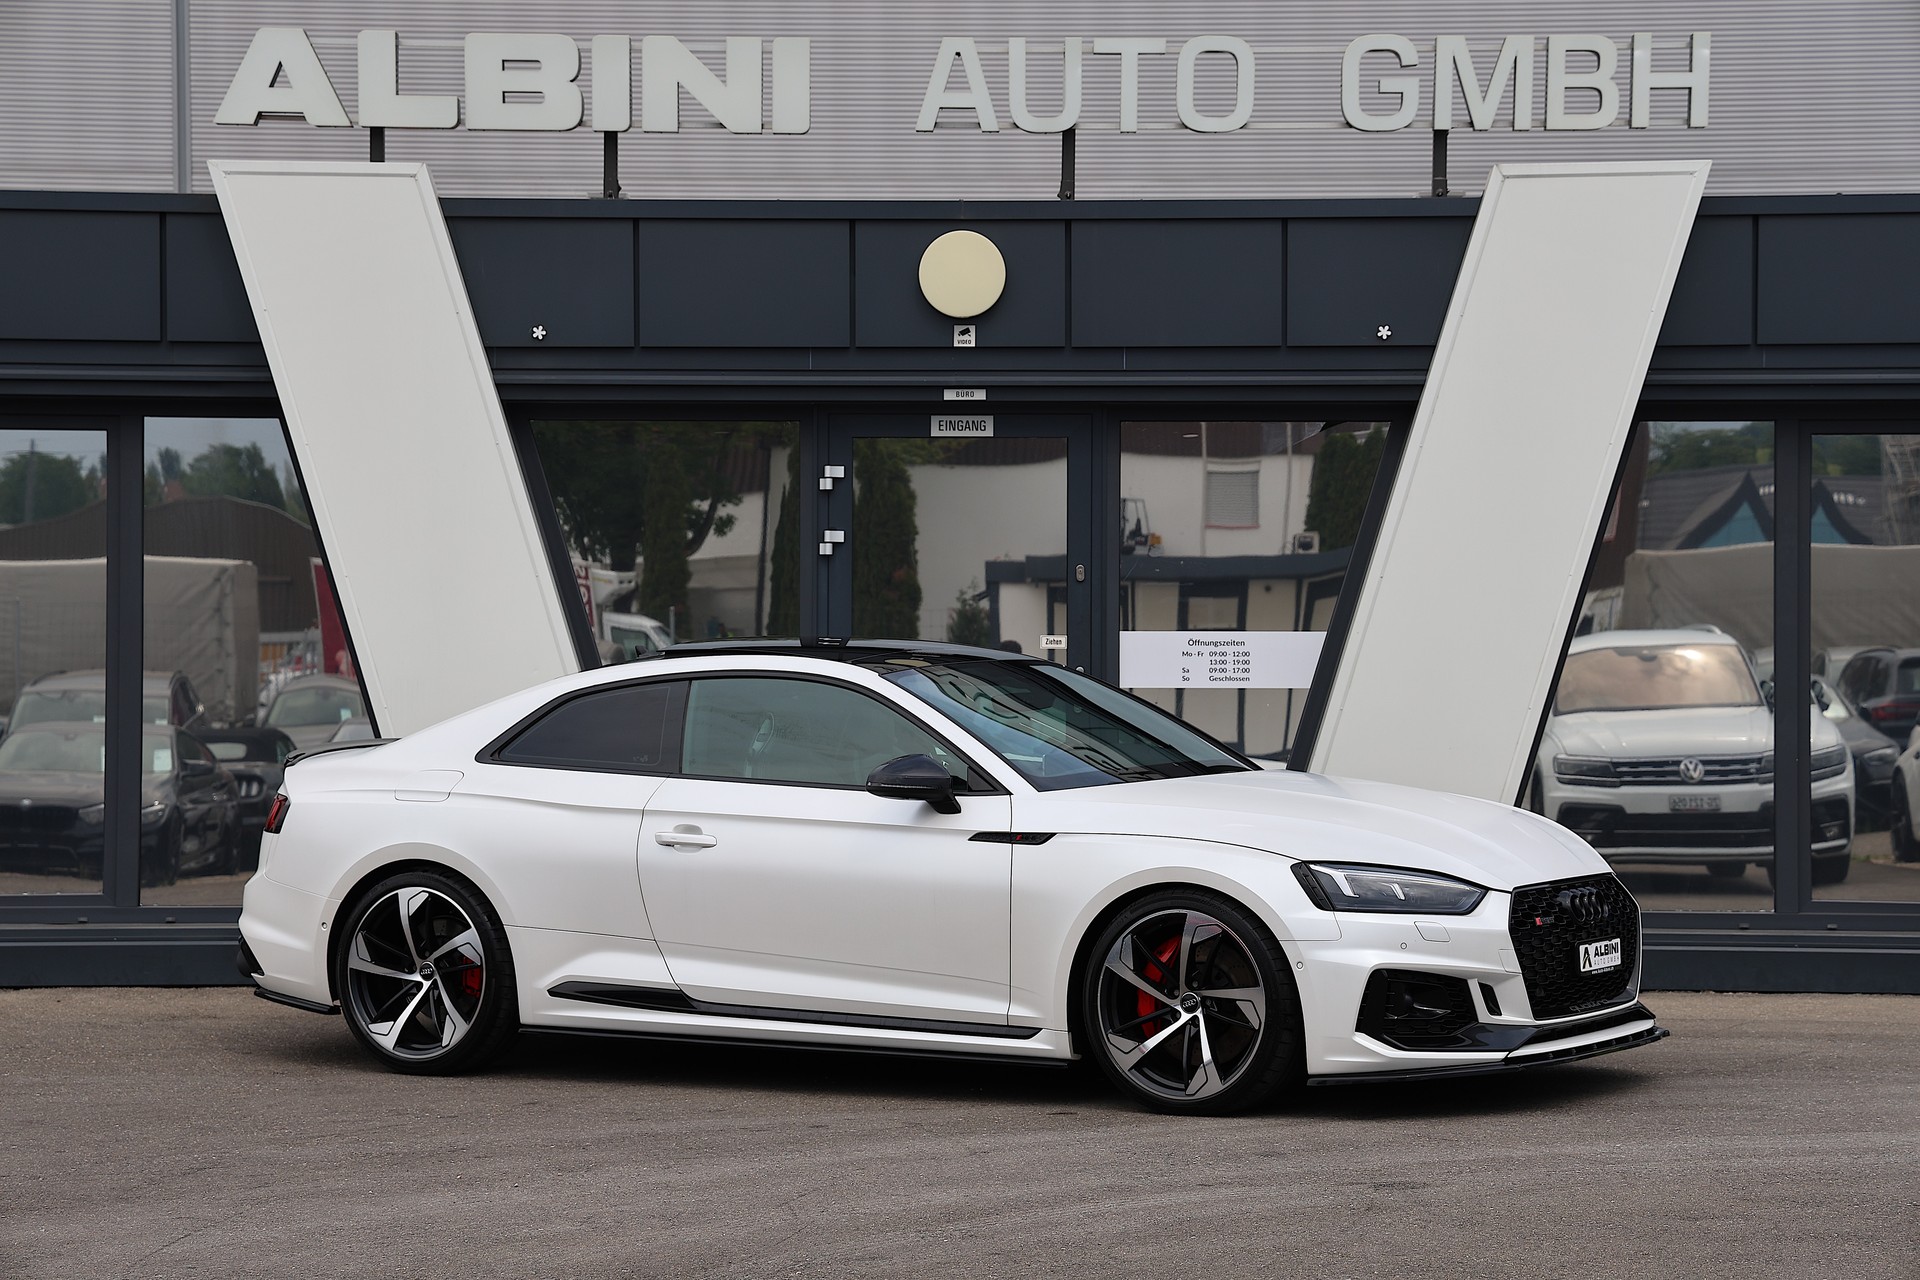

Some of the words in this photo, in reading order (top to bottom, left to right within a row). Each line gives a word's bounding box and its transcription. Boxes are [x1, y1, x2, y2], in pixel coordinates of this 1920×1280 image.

[214, 27, 812, 135] ALBINI
[915, 35, 1256, 134] AUTO
[1340, 32, 1713, 133] GMBH
[955, 389, 975, 398] BÜRO
[938, 420, 987, 432] EINGANG
[1045, 637, 1063, 645] Ziehen
[1187, 638, 1246, 648] Öffnungszeiten
[1593, 941, 1619, 959] ALBINI
